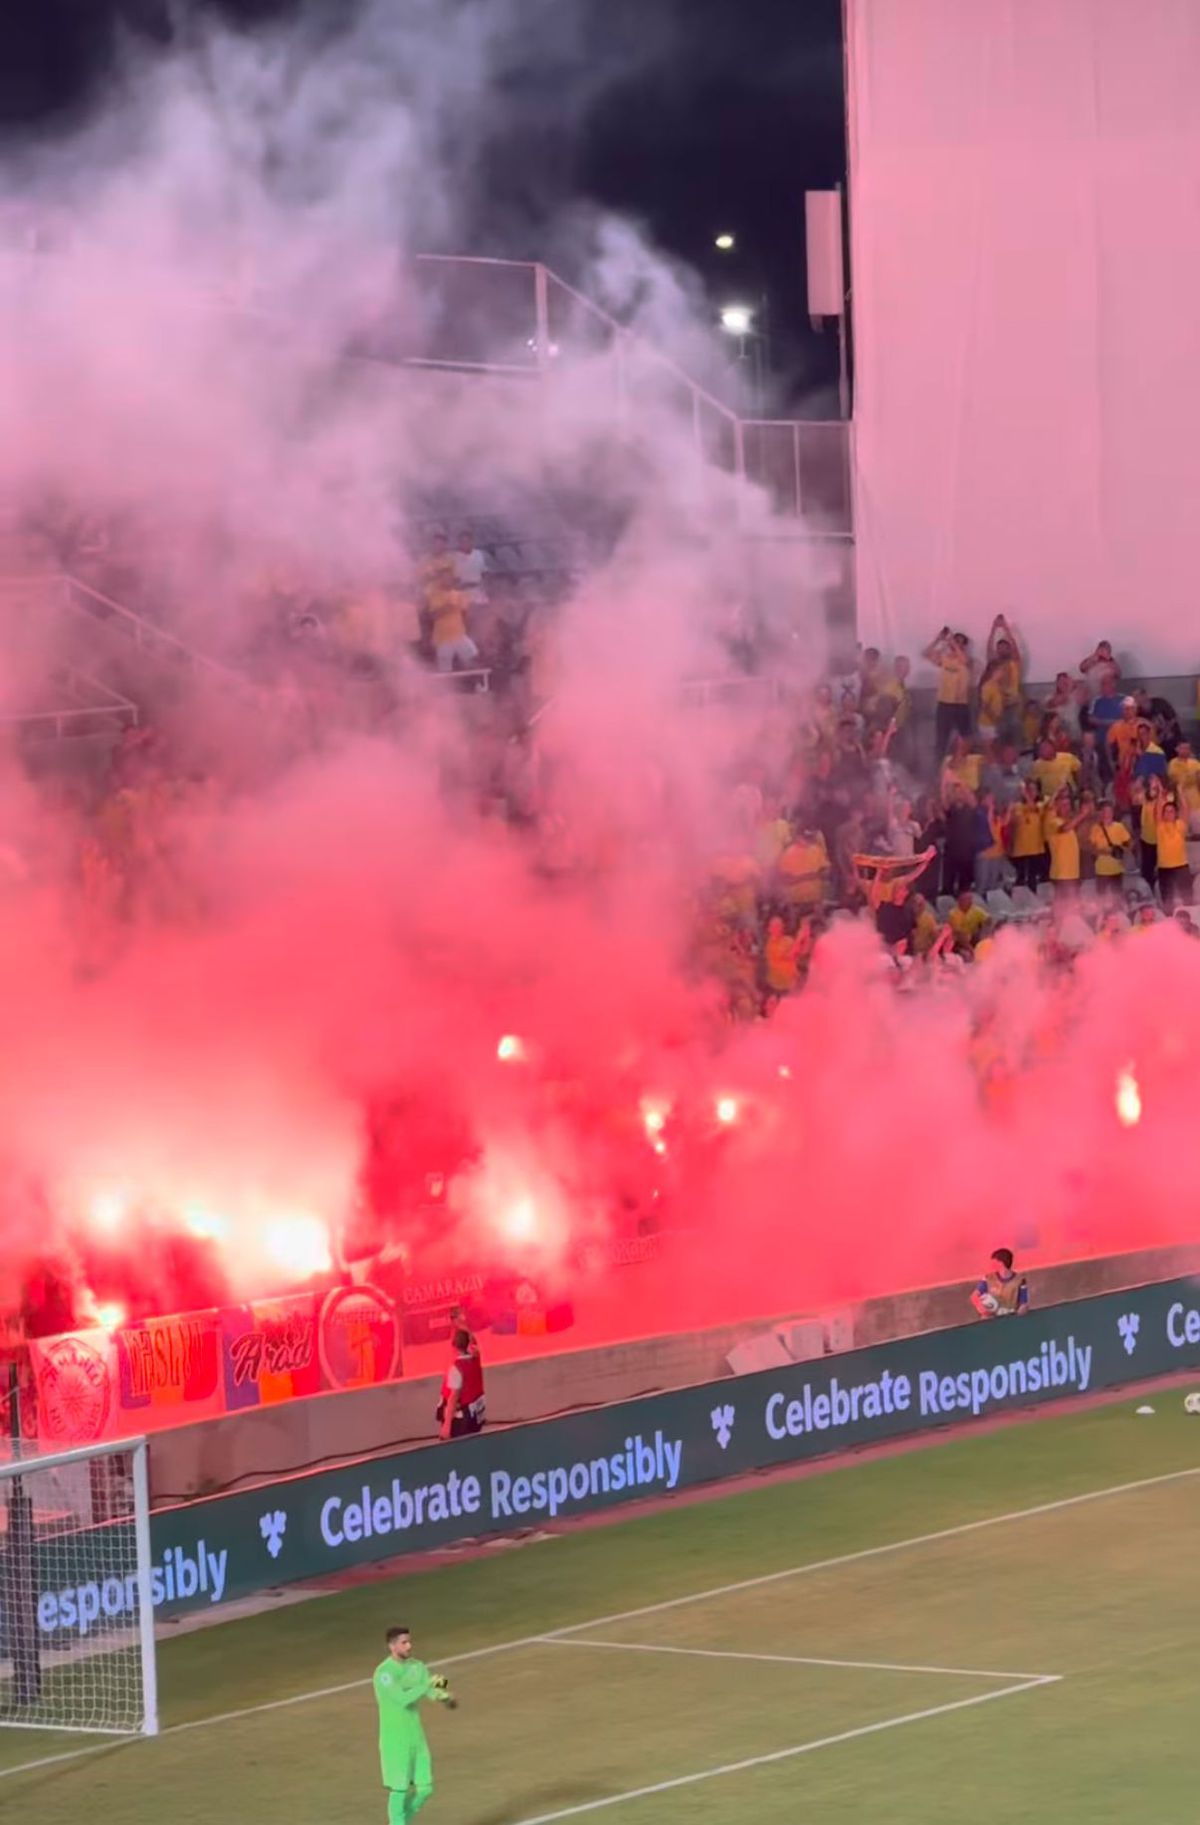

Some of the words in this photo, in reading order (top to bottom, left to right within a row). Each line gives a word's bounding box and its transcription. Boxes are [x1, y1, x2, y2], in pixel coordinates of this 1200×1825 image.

[229, 1322, 314, 1387] Arad
[764, 1369, 911, 1440] Celebrate
[918, 1335, 1092, 1416] Responsibly
[319, 1469, 482, 1547] Celebrate
[490, 1430, 683, 1518] Responsibly
[37, 1539, 228, 1635] esponsibly
